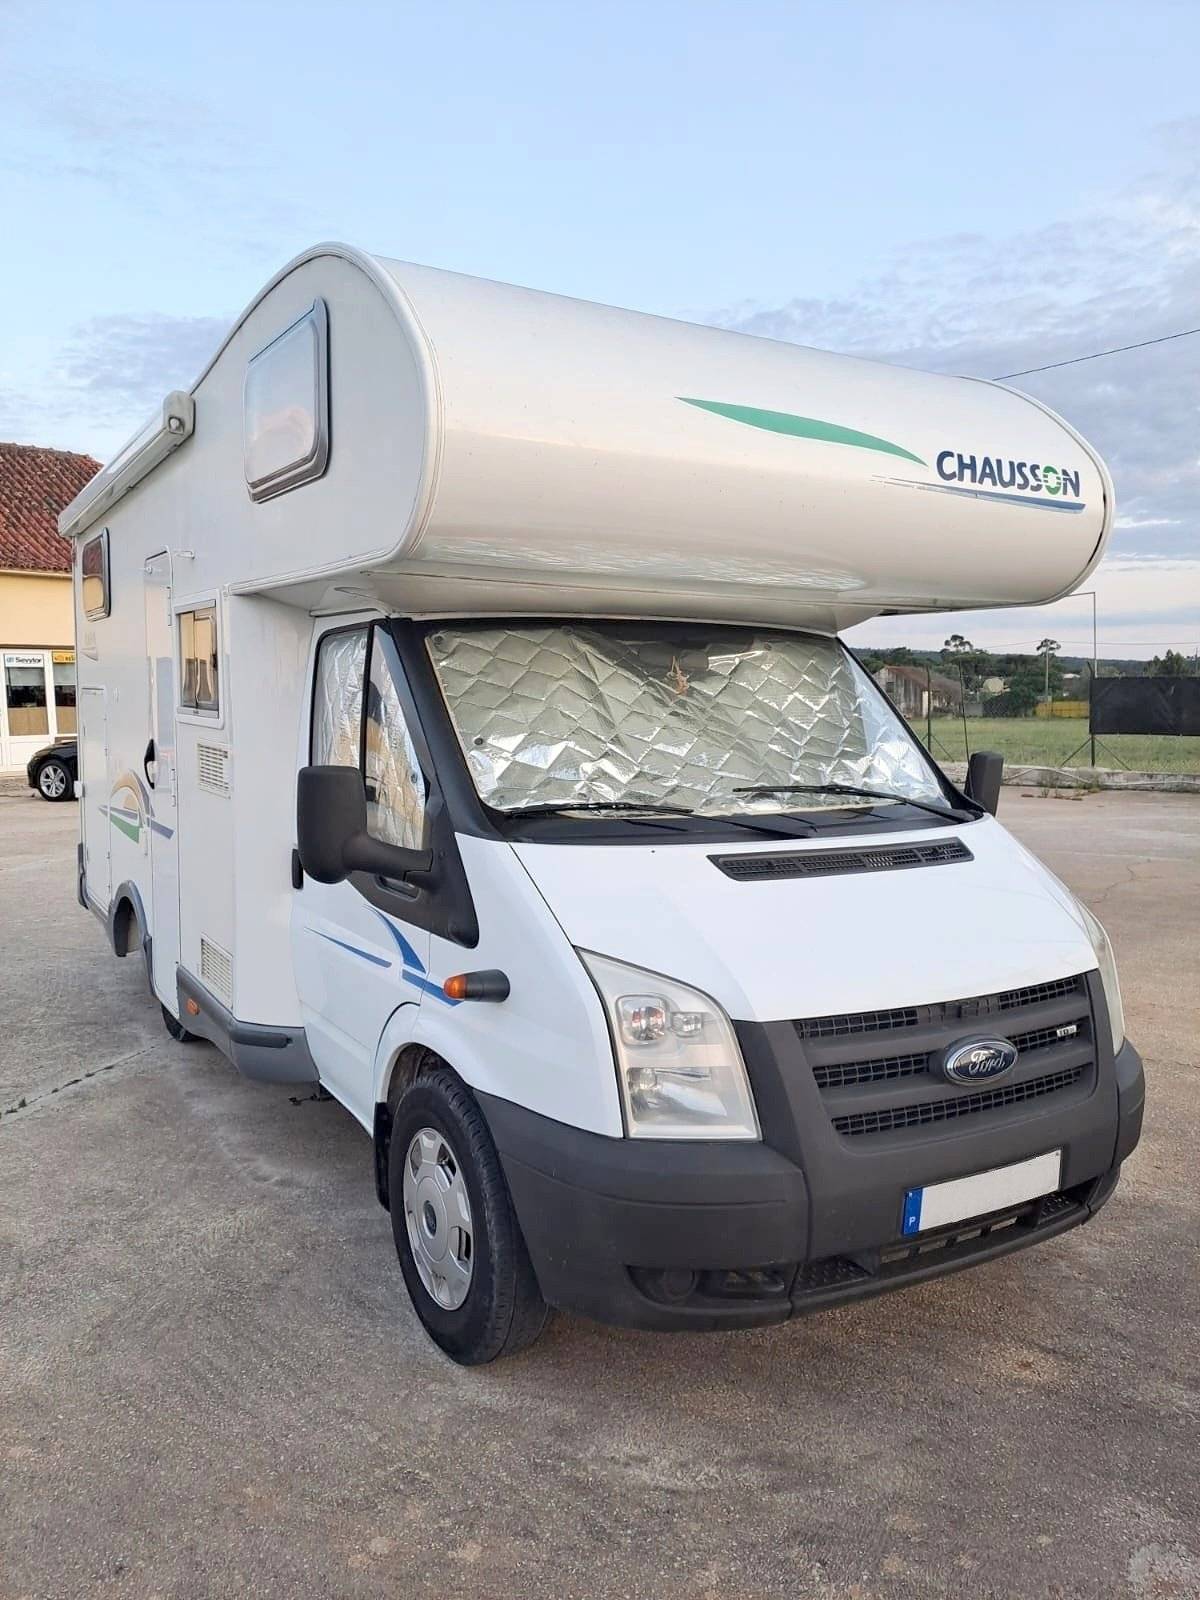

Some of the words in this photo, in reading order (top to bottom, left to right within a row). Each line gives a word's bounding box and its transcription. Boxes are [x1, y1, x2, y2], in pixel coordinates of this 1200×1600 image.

[936, 451, 1080, 497] CHAUSSON
[969, 1049, 1006, 1074] Ford
[909, 1216, 916, 1227] P
